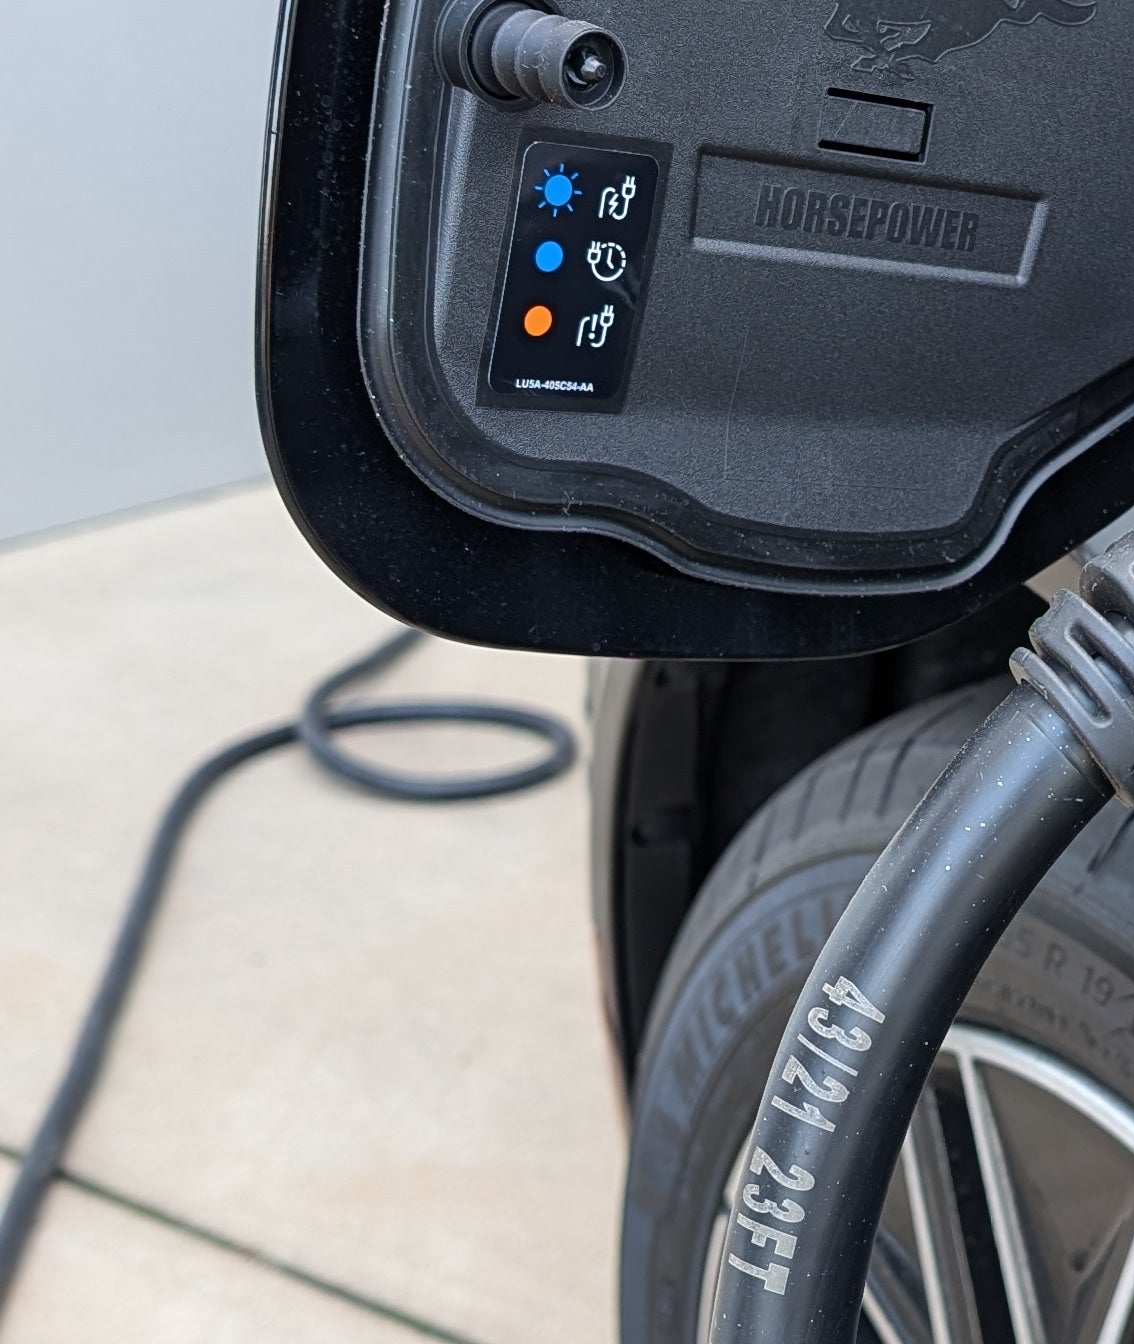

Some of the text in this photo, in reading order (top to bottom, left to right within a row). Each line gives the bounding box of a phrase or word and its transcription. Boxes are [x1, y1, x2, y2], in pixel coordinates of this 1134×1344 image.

[755, 184, 979, 252] HORSEPOWER
[670, 897, 836, 1105] MICHELI
[728, 975, 886, 1295] 43/21 23FT
